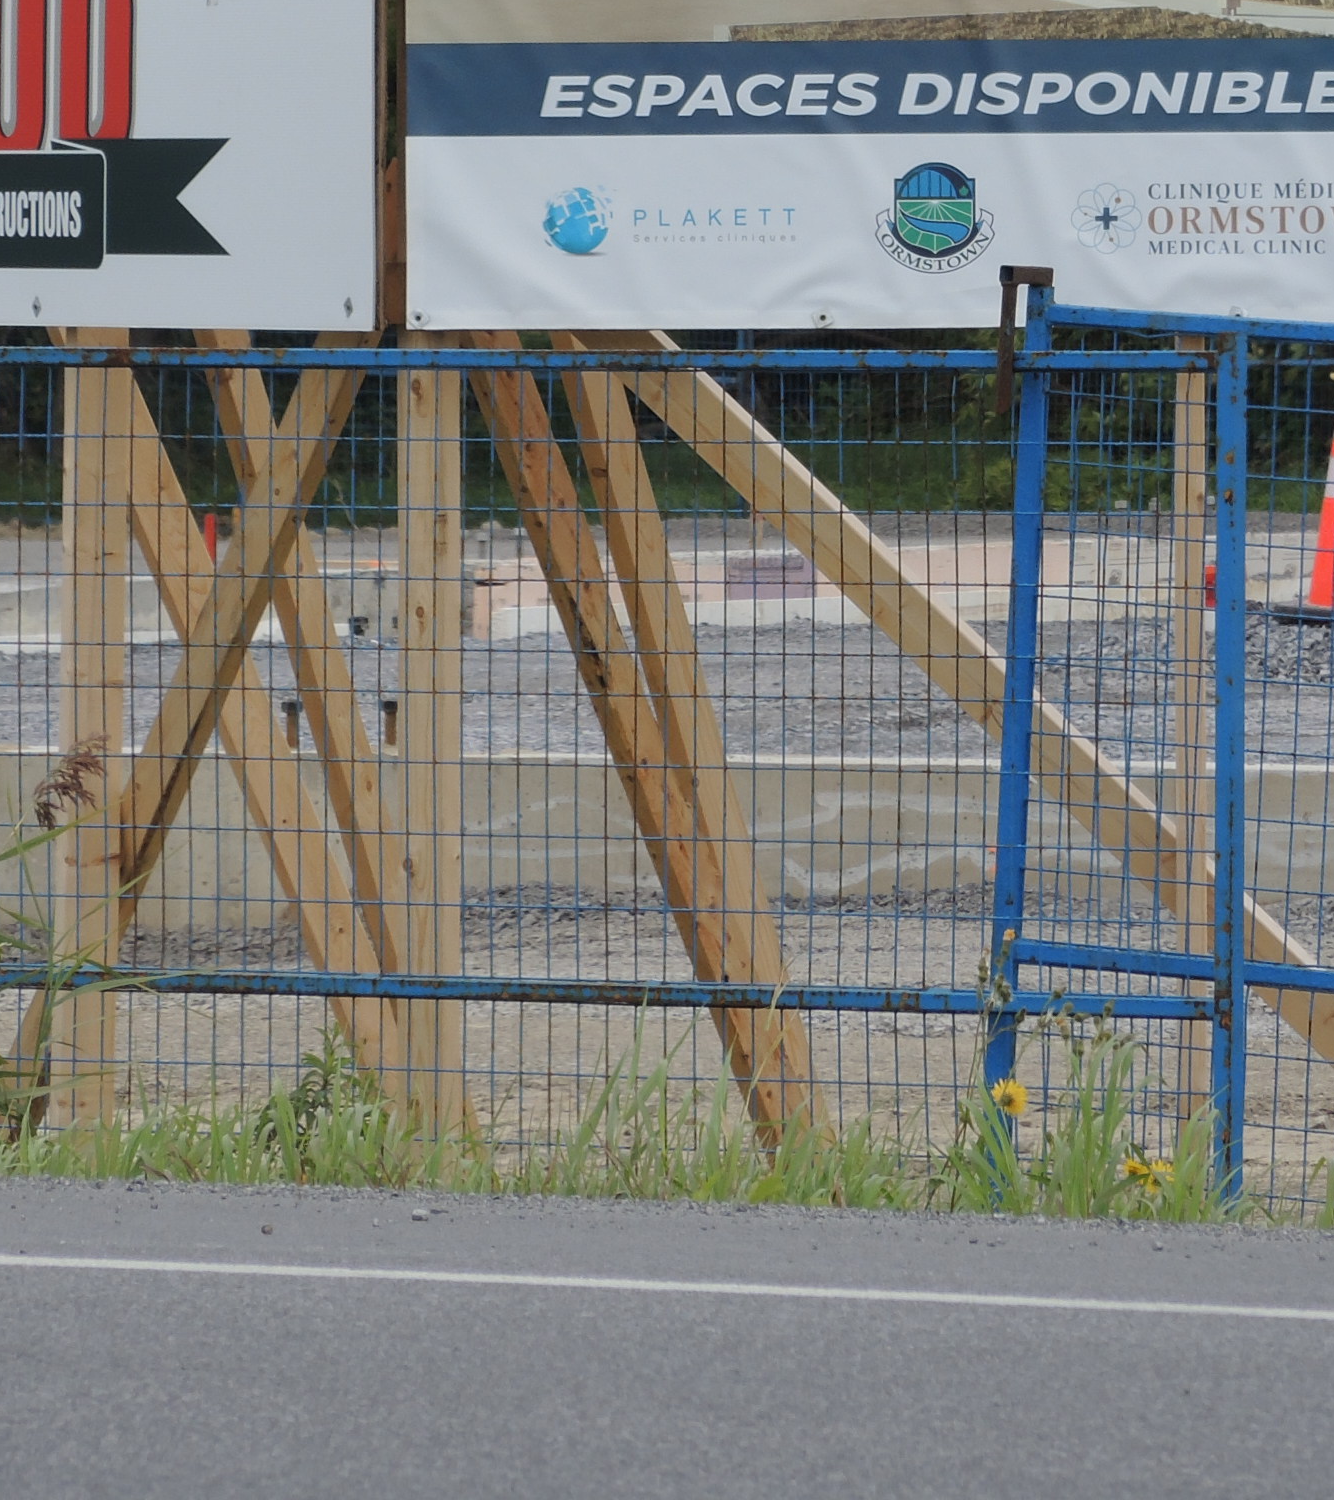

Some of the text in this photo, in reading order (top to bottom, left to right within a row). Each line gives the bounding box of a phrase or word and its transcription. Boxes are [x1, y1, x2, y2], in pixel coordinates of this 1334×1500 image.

[539, 73, 881, 118] ESPACES
[1147, 182, 1263, 204] CLINIQUE
[633, 208, 796, 227] PLAKETT
[633, 232, 797, 244] Services cliniques
[1147, 239, 1326, 255] MEDICAL CLINIC
[881, 232, 990, 271] ORMSTOWN
